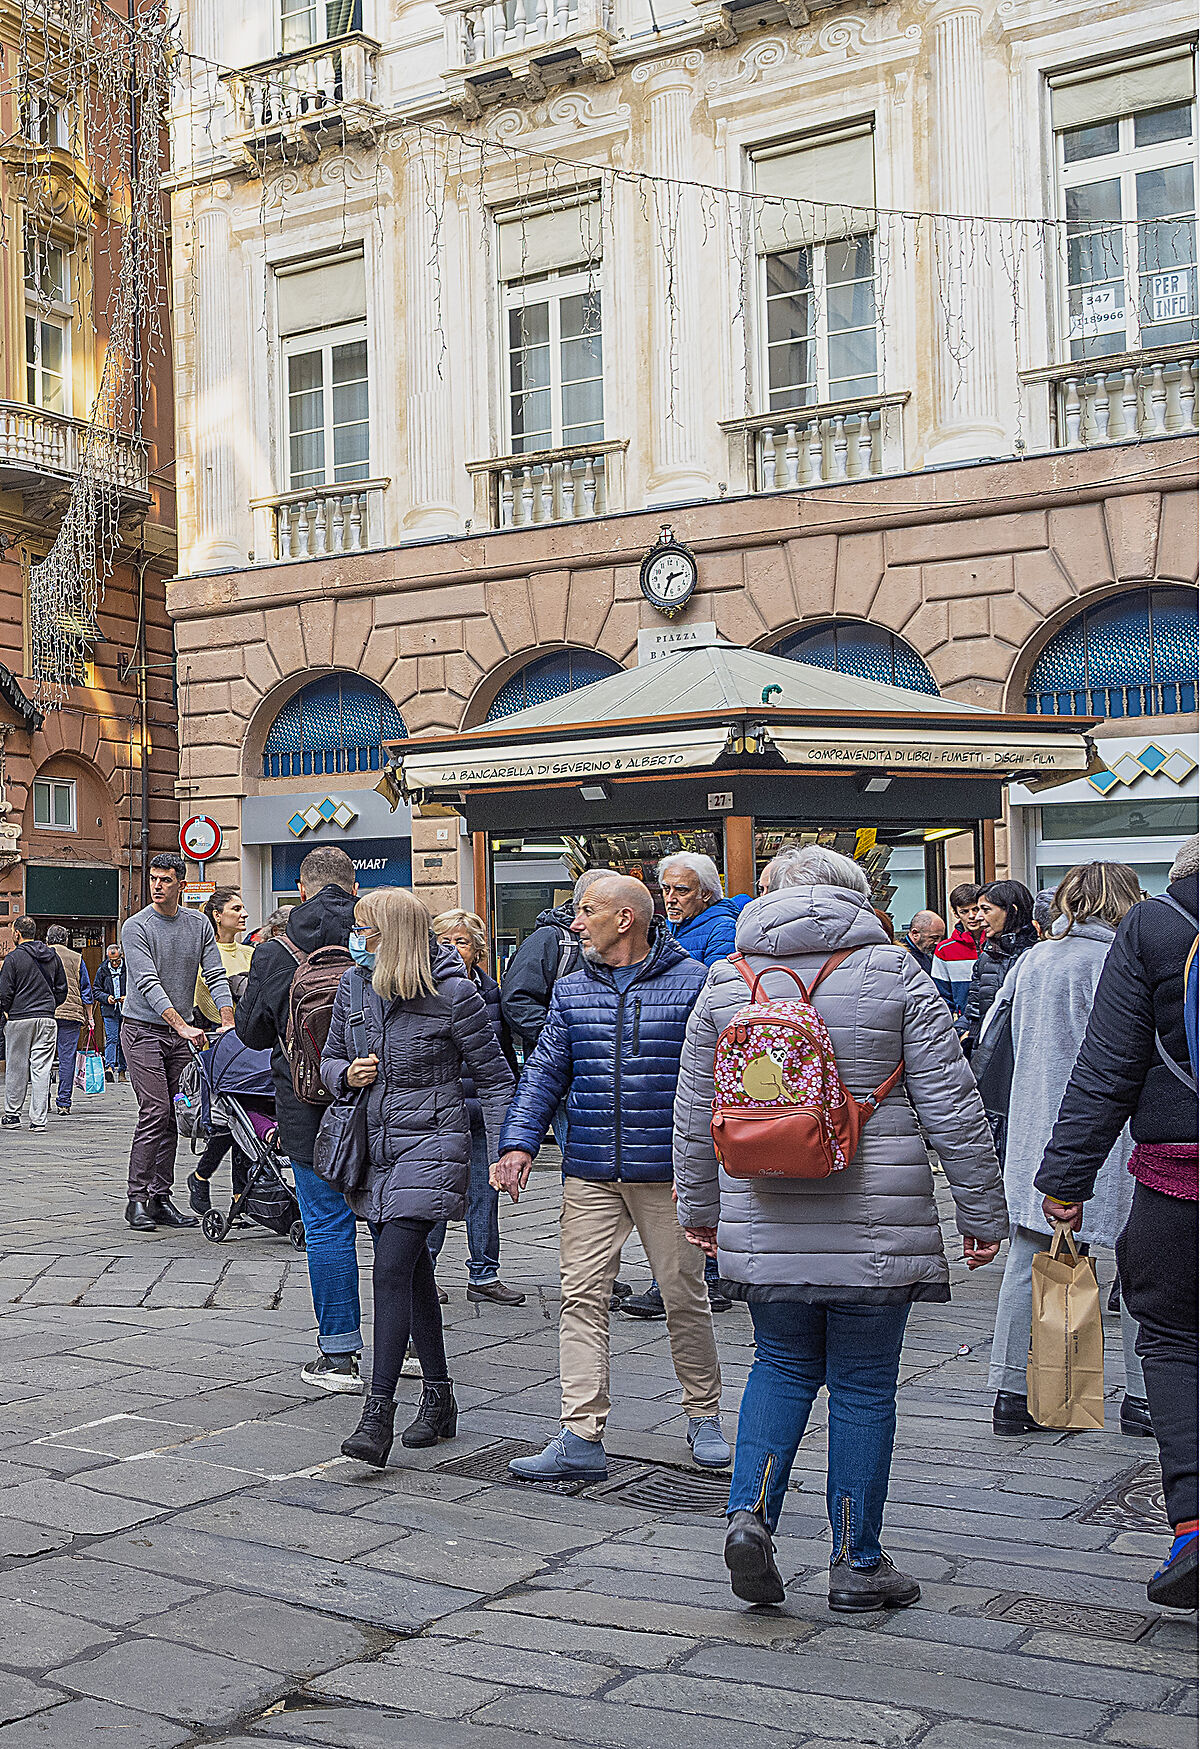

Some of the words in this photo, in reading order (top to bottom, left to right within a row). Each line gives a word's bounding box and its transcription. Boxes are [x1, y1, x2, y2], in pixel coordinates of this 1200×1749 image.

[1154, 274, 1179, 296] PER
[1086, 293, 1110, 306] 347
[1155, 296, 1186, 318] INFO
[656, 632, 697, 643] PIAZZA
[807, 748, 892, 762] COMPRAVENDITA
[894, 750, 906, 762] DI
[907, 751, 932, 762] LIBRI
[941, 751, 984, 763] FUMETTI
[994, 753, 1024, 764] DISCHI
[1032, 753, 1056, 764] FILM
[441, 771, 457, 782] LA
[459, 766, 534, 780] BANCARELLA
[537, 764, 550, 775] DI
[552, 760, 611, 775] SEVERINO
[615, 758, 624, 769] &
[627, 754, 684, 768] ALBERTO
[714, 795, 726, 806] 27
[351, 858, 388, 870] SMART
